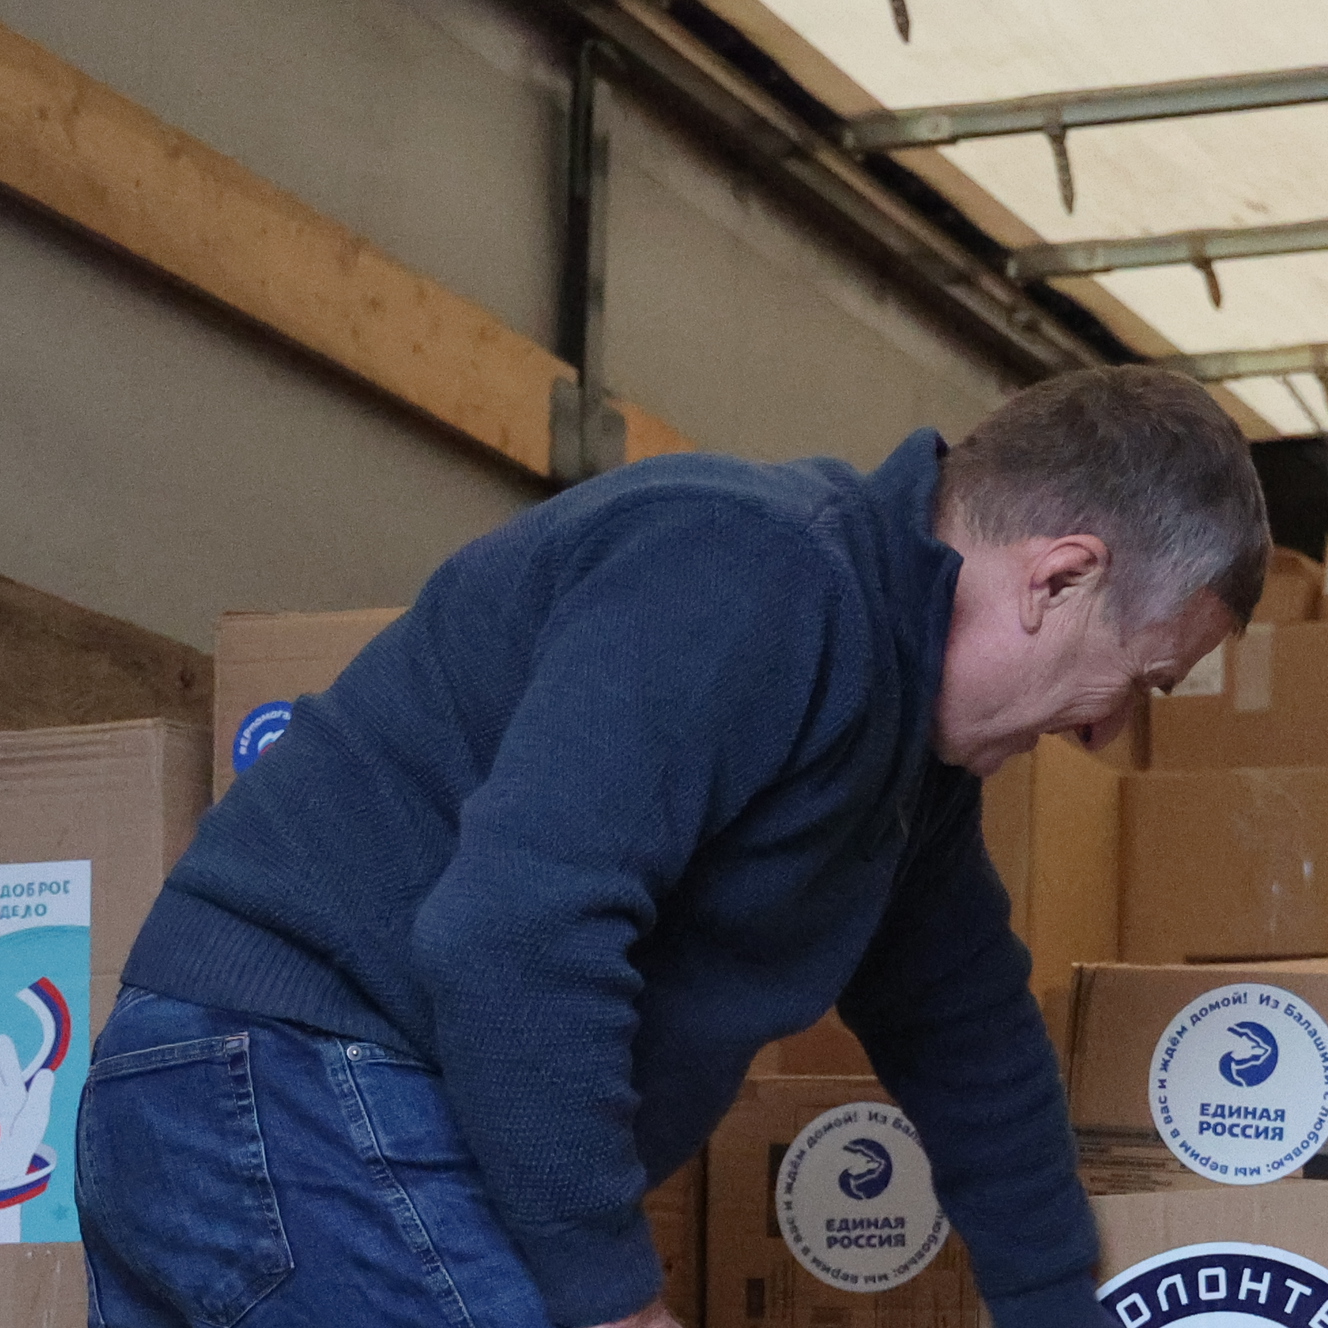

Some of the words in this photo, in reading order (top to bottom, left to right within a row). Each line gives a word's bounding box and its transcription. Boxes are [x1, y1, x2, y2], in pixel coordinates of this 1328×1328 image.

[0, 880, 71, 899] ДОБРОЕ
[0, 904, 47, 920] ДЕЛО
[1190, 992, 1247, 1026] домой!
[1259, 994, 1280, 1009] Из
[1160, 1025, 1188, 1072] ждём
[1158, 1079, 1167, 1089] и
[1158, 1095, 1173, 1124] вас
[1199, 1103, 1286, 1122] ЕДИНАЯ
[1170, 1128, 1180, 1139] в
[1198, 1121, 1284, 1141] РОССИЯ
[1266, 1106, 1328, 1172] любовью:
[1179, 1140, 1228, 1175] верим
[1234, 1166, 1261, 1176] мы
[825, 1217, 906, 1233] ЕДИНАЯ
[826, 1234, 906, 1249] РОССИЯ
